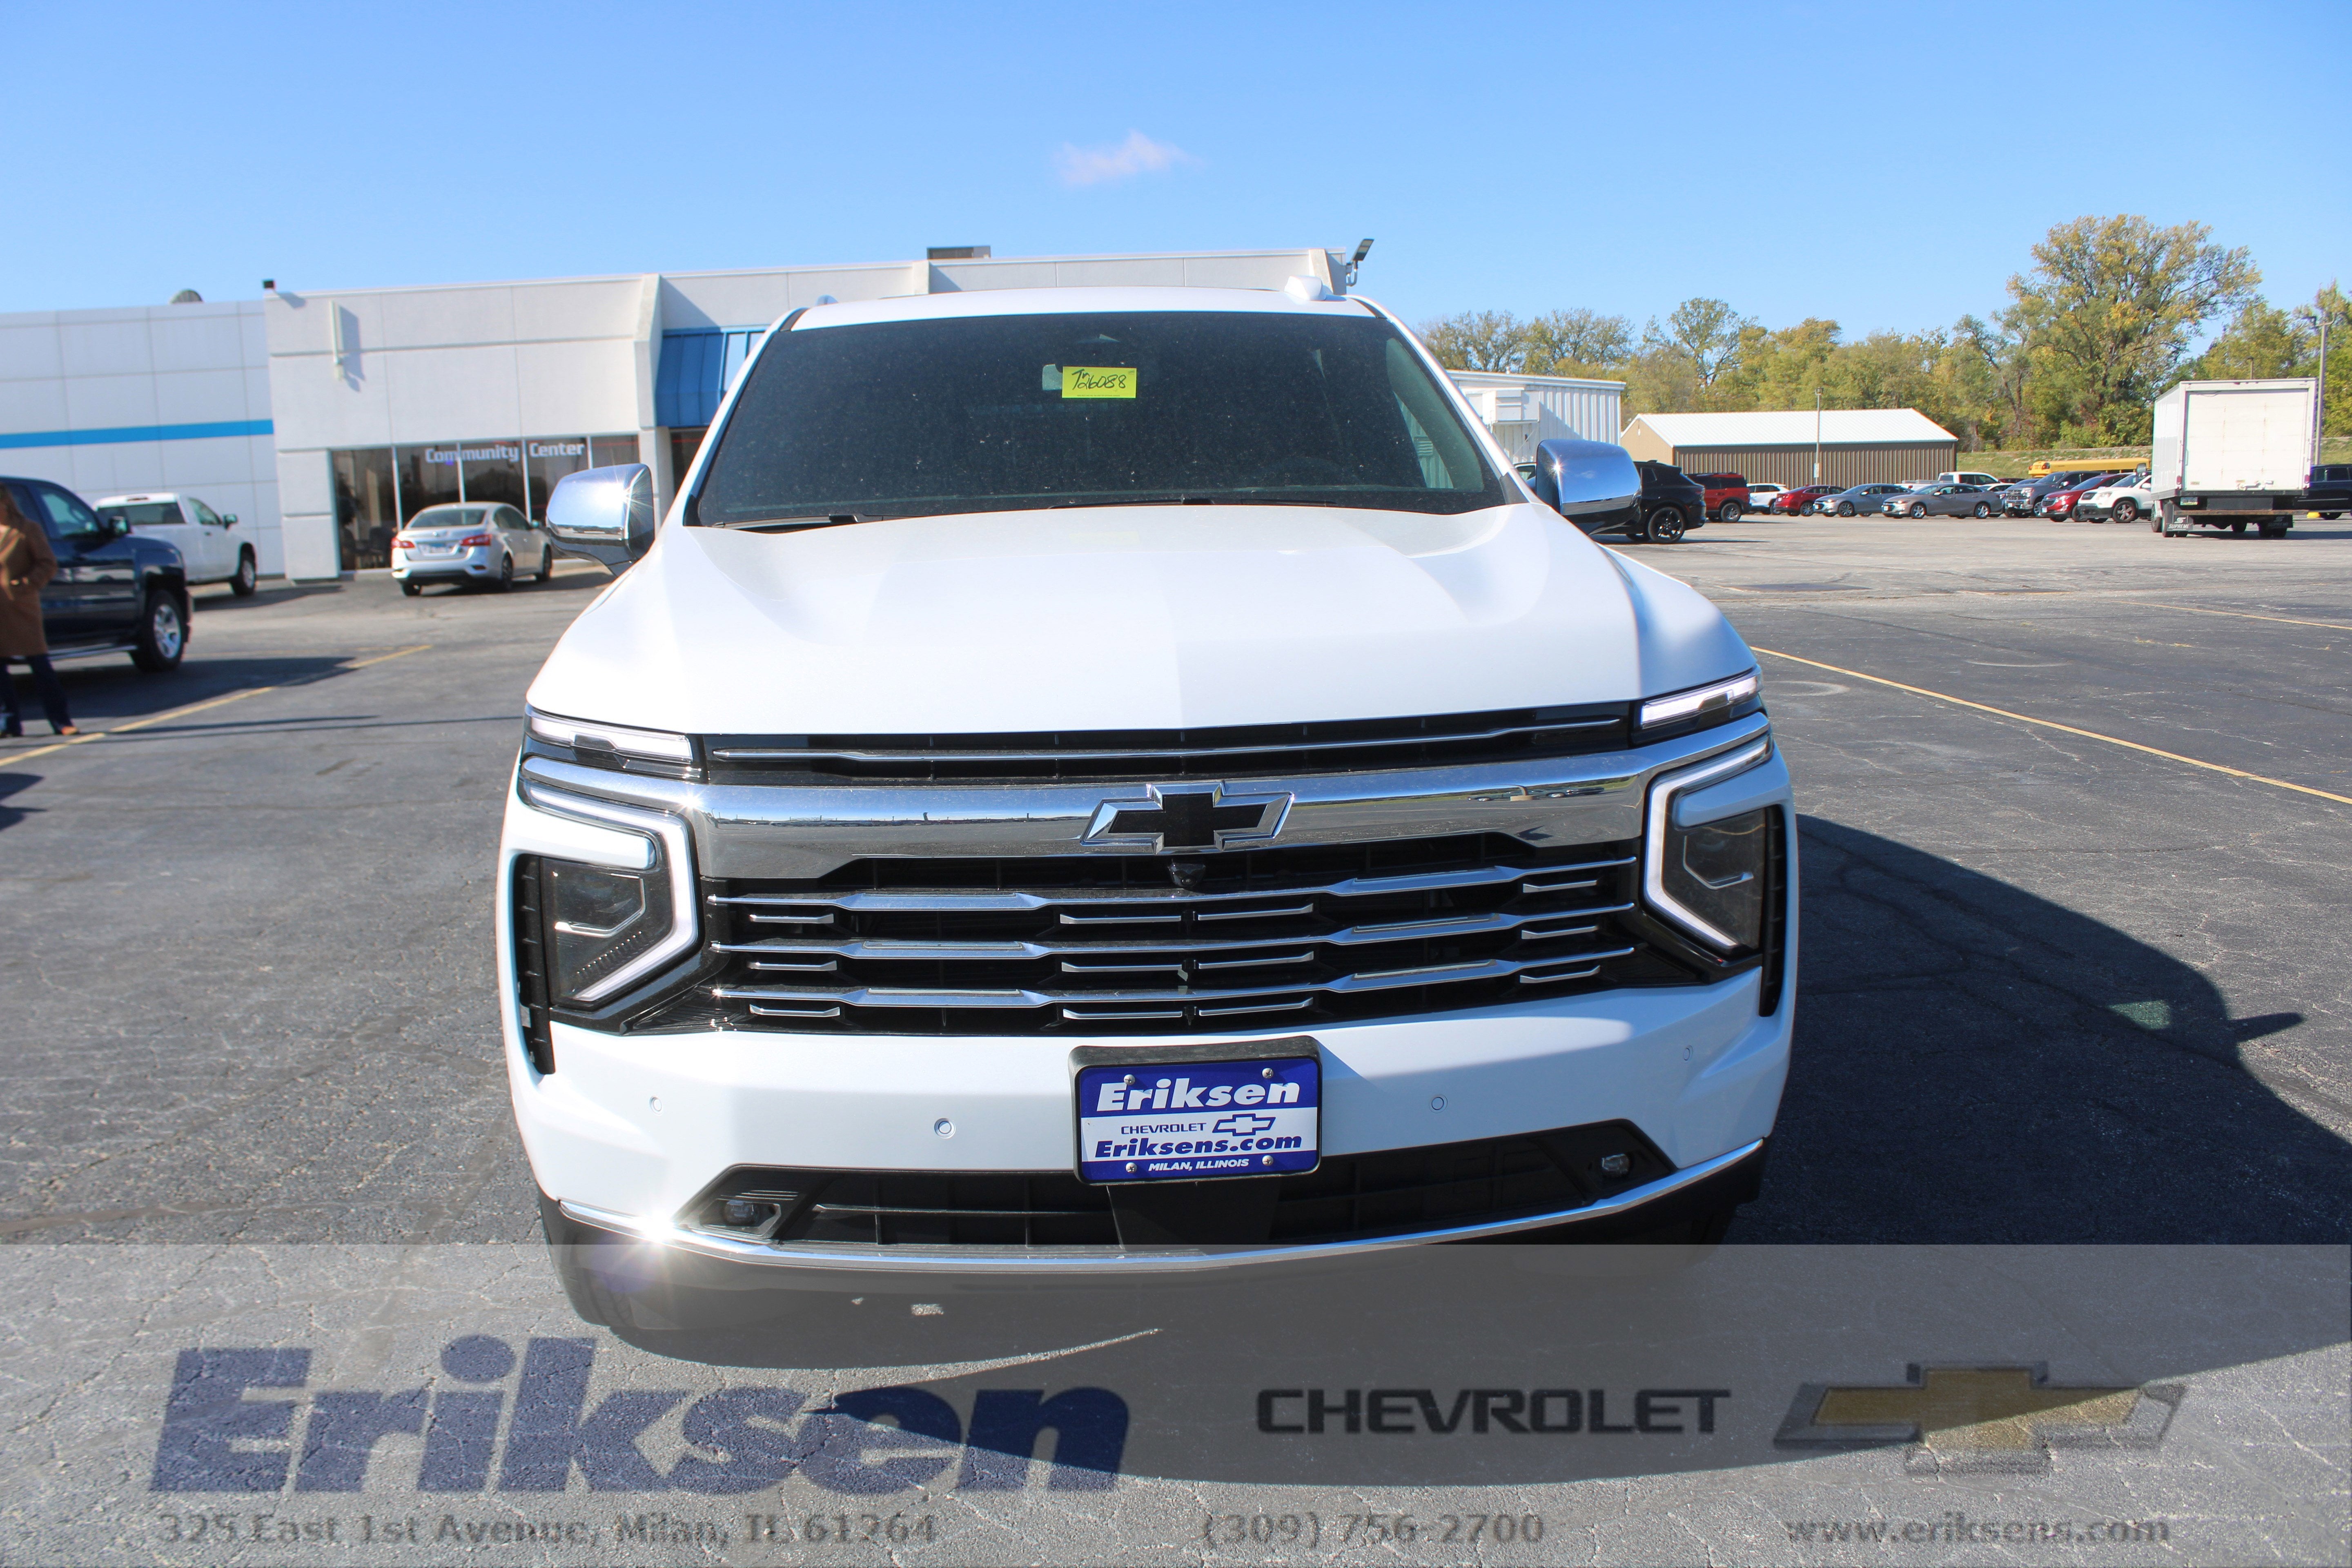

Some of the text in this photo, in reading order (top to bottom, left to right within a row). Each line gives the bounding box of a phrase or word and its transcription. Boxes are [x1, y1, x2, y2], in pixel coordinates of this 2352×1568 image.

[1072, 368, 1127, 390] T26088
[425, 442, 585, 463] Community Center
[1096, 1078, 1301, 1112] Eriksen
[1121, 1123, 1207, 1135] CHEVROLET
[1095, 1136, 1302, 1158] Eriksens.com
[1148, 1158, 1250, 1172] MILAN, ILLINOIS
